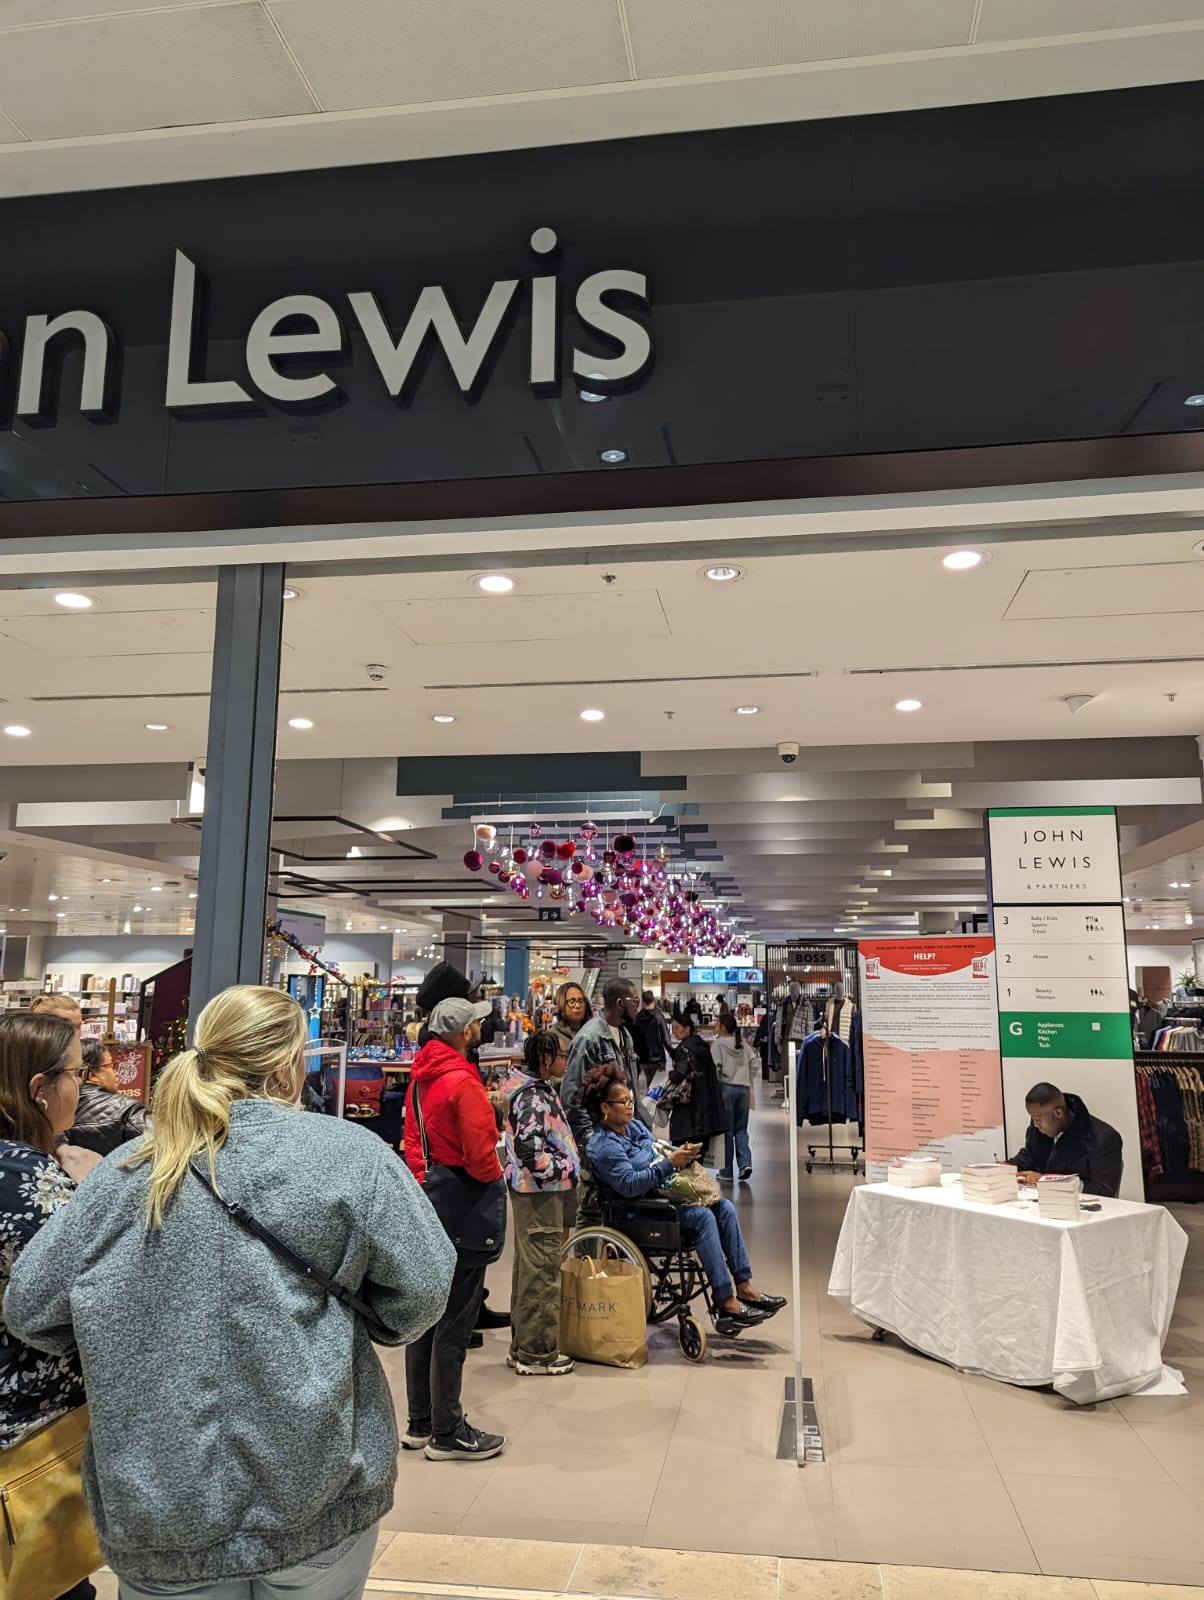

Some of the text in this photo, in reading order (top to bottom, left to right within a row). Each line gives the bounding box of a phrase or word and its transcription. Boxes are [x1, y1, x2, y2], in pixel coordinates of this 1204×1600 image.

[165, 227, 652, 409] Lewis
[1023, 829, 1084, 844] JOHN
[1019, 856, 1091, 869] LEWIS
[1003, 916, 1009, 925] 3
[796, 953, 827, 963] BOSS
[913, 952, 936, 961] HELP?
[1005, 954, 1012, 963] 2
[621, 962, 628, 970] G
[1006, 988, 1011, 997] 1
[1009, 1021, 1023, 1036] G
